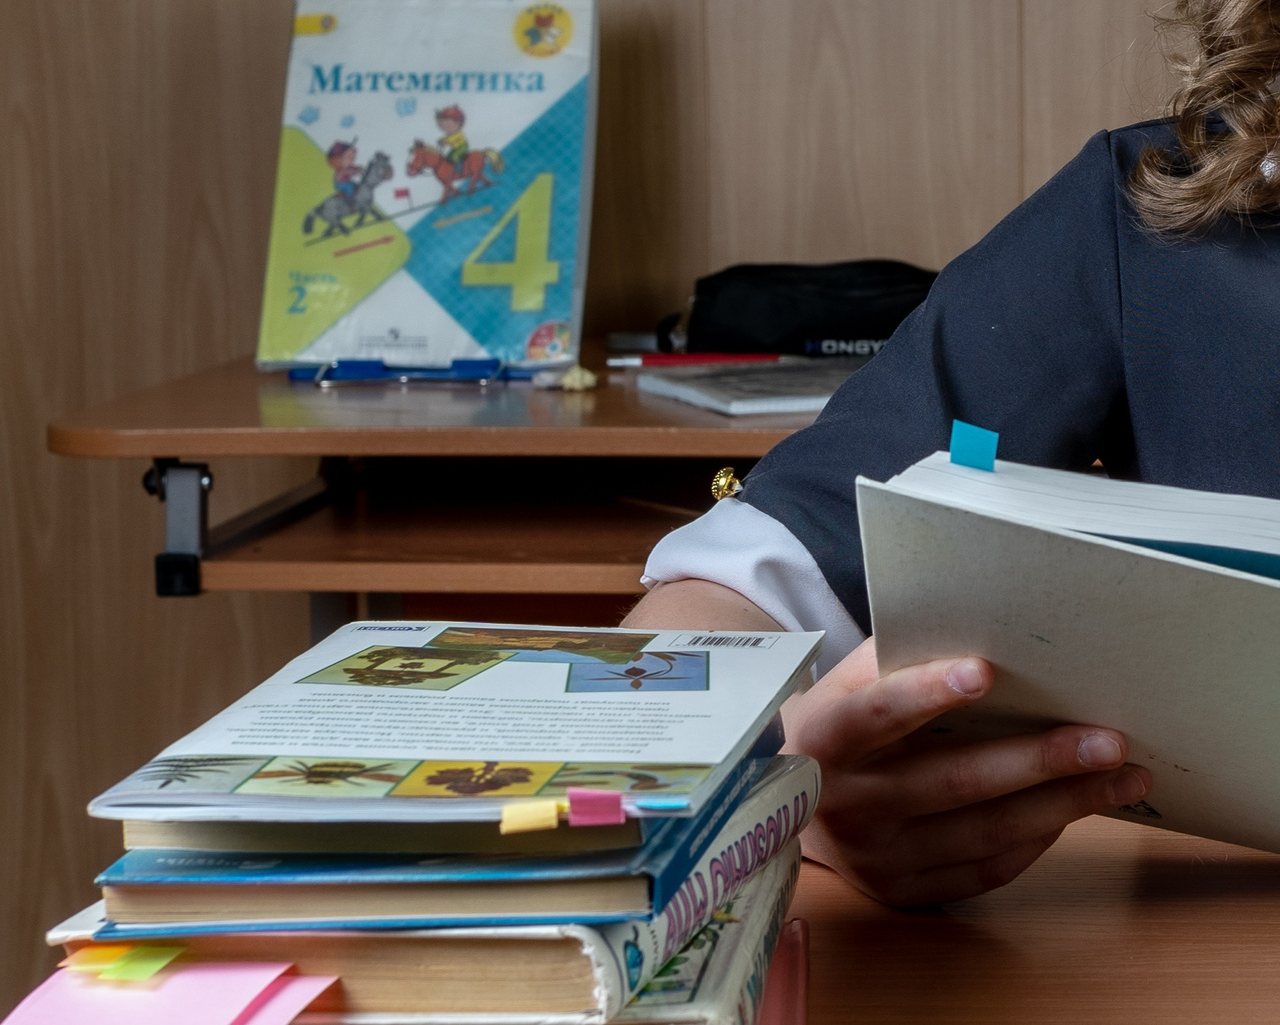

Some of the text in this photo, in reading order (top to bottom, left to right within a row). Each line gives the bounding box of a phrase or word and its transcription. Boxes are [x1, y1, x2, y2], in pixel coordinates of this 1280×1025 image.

[308, 62, 546, 95] Математика
[461, 171, 560, 312] 4
[287, 286, 307, 314] 2
